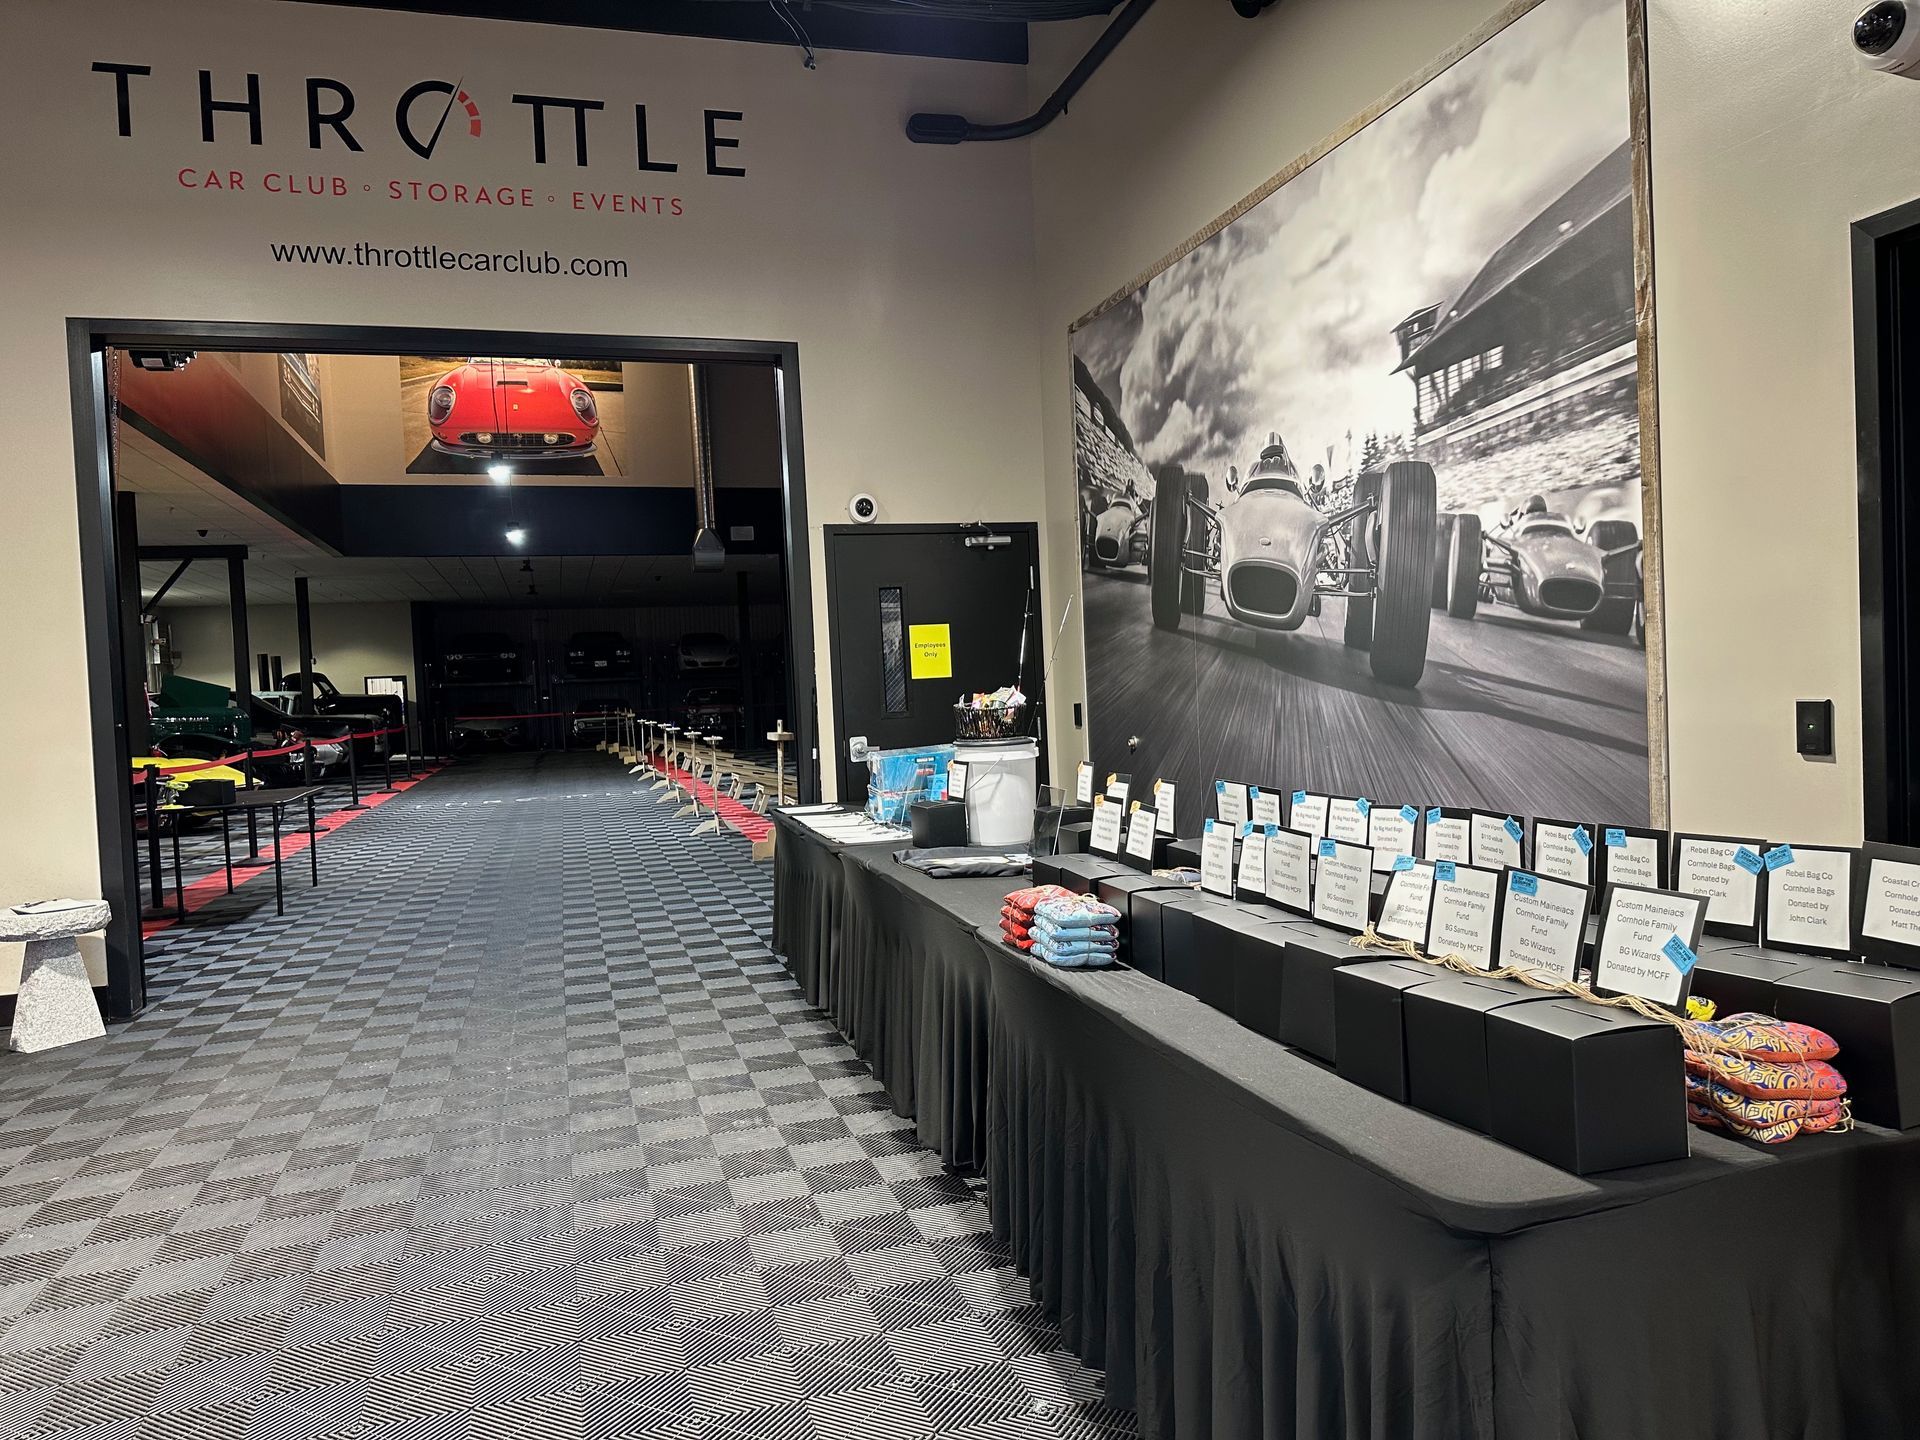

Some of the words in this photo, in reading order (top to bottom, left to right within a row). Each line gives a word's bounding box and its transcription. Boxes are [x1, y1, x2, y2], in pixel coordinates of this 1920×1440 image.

[178, 168, 245, 191] CAR
[263, 173, 349, 196] CLUB
[388, 180, 534, 207] STORAGE
[573, 191, 685, 216] EVENTS
[270, 241, 628, 278] www.throttlecarclub.com
[1545, 830, 1557, 838] Rebel
[1481, 844, 1498, 853] Donated
[1543, 842, 1563, 852] Cornhole
[1564, 846, 1576, 855] Bags
[1690, 846, 1708, 854] Rebel
[1710, 848, 1723, 857] Bag
[1724, 849, 1734, 857] Co
[1324, 858, 1339, 868] Custom
[1546, 855, 1566, 864] Donated
[1615, 853, 1630, 861] Rebel
[1630, 855, 1640, 863] Bag
[1688, 860, 1718, 869] Cornhole
[1719, 863, 1736, 871] Bags
[1325, 869, 1343, 879] Cornhole
[1344, 873, 1358, 883] Family
[1558, 869, 1571, 877] Clark
[1613, 866, 1637, 875] Cornhole
[1638, 869, 1652, 877] Bags
[1786, 869, 1805, 877] Rebel
[1806, 871, 1820, 880] Bag
[1822, 872, 1833, 880] Co
[1272, 880, 1286, 888] Donated
[1692, 874, 1720, 883] Donated
[1721, 877, 1730, 885] by
[1882, 876, 1910, 887] Coastal
[1335, 882, 1346, 890] Fund
[1400, 881, 1423, 890] Cornhole
[1783, 884, 1815, 894] Cornhole
[1817, 887, 1835, 896] Bags
[1410, 891, 1423, 901] Fund
[1443, 884, 1462, 893] Custom
[1463, 888, 1490, 899] Maineiacs
[1709, 890, 1727, 898] Clark
[1885, 890, 1918, 902] Cornhole
[1334, 894, 1354, 905] Sorcerers
[1444, 897, 1467, 908] Cornhole
[1468, 901, 1485, 912] Family
[1514, 893, 1538, 906] Custom
[1540, 900, 1574, 916] Maineiacs
[1788, 899, 1818, 909] Donated
[1820, 902, 1829, 911] by
[1322, 904, 1339, 914] Donated
[1339, 908, 1344, 916] by
[1345, 909, 1358, 919] MCFF
[1616, 900, 1643, 911] Custom
[1644, 904, 1684, 917] Maineiacs
[1889, 905, 1920, 916] Donated
[1388, 916, 1408, 925] Donated
[1408, 919, 1415, 927] by
[1456, 912, 1469, 920] Fund
[1516, 908, 1545, 921] Cornhole
[1546, 915, 1568, 929] Family
[1789, 914, 1805, 922] John
[1807, 916, 1827, 925] Clark
[1617, 914, 1650, 926] Cornhole
[1651, 920, 1677, 933] Family
[1892, 920, 1907, 930] Matt
[1454, 925, 1478, 937] Samurais
[1531, 925, 1548, 936] Fund
[1633, 932, 1652, 942] Fund
[1438, 937, 1459, 948] Donated
[1460, 942, 1466, 950] by
[1467, 943, 1484, 953] MCFF
[1520, 938, 1529, 947] BG
[1530, 940, 1556, 955] Wizards
[1619, 946, 1630, 955] BG
[1631, 948, 1661, 961] Wizards
[1510, 950, 1535, 964] Donated
[1536, 958, 1544, 968] by
[1545, 959, 1565, 973] MCFF
[1607, 961, 1636, 973] Donated
[1637, 967, 1645, 977] by
[1647, 969, 1670, 980] MCFF
